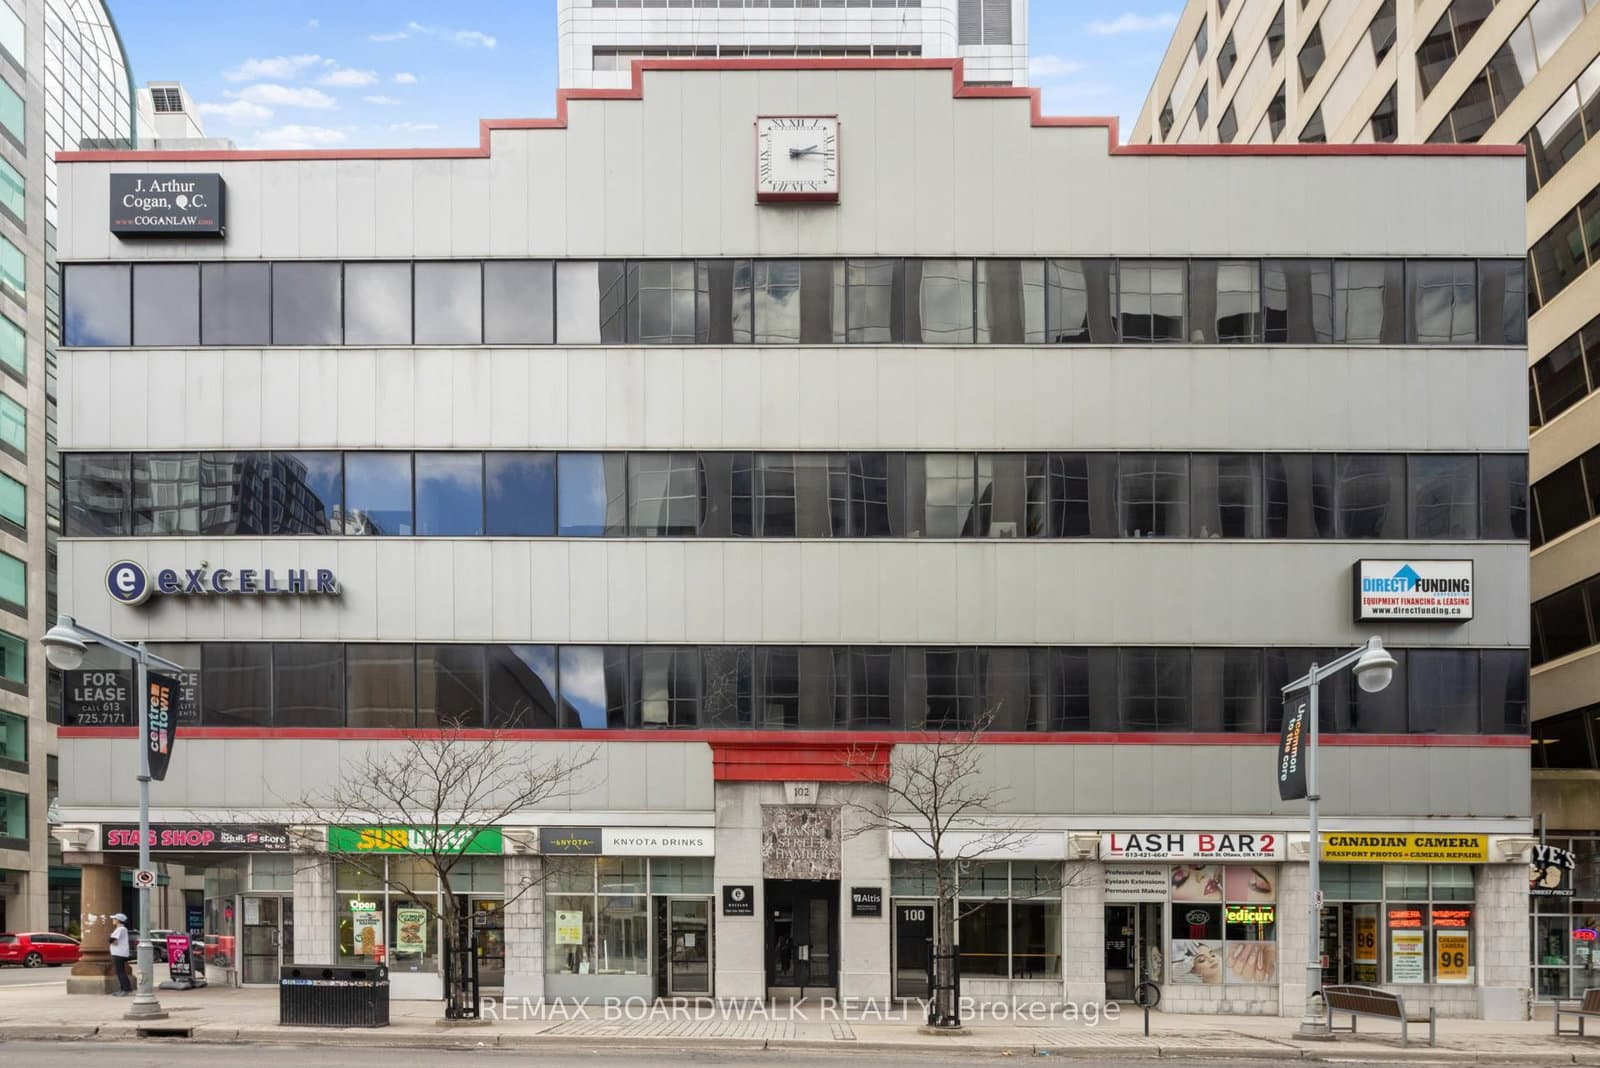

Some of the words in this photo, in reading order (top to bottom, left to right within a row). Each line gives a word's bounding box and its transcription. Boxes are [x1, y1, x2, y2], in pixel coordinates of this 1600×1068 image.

[135, 179, 146, 193] J.
[149, 179, 195, 193] Arthur
[123, 195, 172, 210] Cogan,
[1362, 577, 1408, 593] DIRECT
[1415, 578, 1470, 592] FUNDING
[1363, 597, 1399, 606] EQUIPMENT
[1401, 597, 1436, 606] FINANCING
[1443, 598, 1470, 606] LEASING
[1372, 607, 1461, 616] www.directfunding.ca
[83, 672, 117, 687] FOR
[74, 687, 127, 702] LEASE
[103, 703, 120, 711] 613
[78, 713, 126, 724] 725.7171
[149, 697, 160, 752] centre
[1290, 703, 1306, 773] Uncommon
[1280, 754, 1290, 782] core
[794, 787, 810, 798] 102
[161, 830, 215, 846] SHOP
[258, 835, 286, 844] store
[613, 838, 657, 847] KNYOTA
[662, 838, 704, 847] DRINKS
[1110, 833, 1184, 852] LASH
[1328, 836, 1407, 848] CANADIAN
[1414, 837, 1479, 849] CAMERA
[1326, 850, 1368, 858] PASSPORT
[1410, 851, 1444, 859] CAMERA
[1534, 844, 1576, 870] YE'S
[350, 899, 377, 910] Open
[861, 894, 881, 903] Altis
[904, 909, 926, 921] 100
[1357, 933, 1375, 948] 96
[1440, 952, 1465, 968] 96
